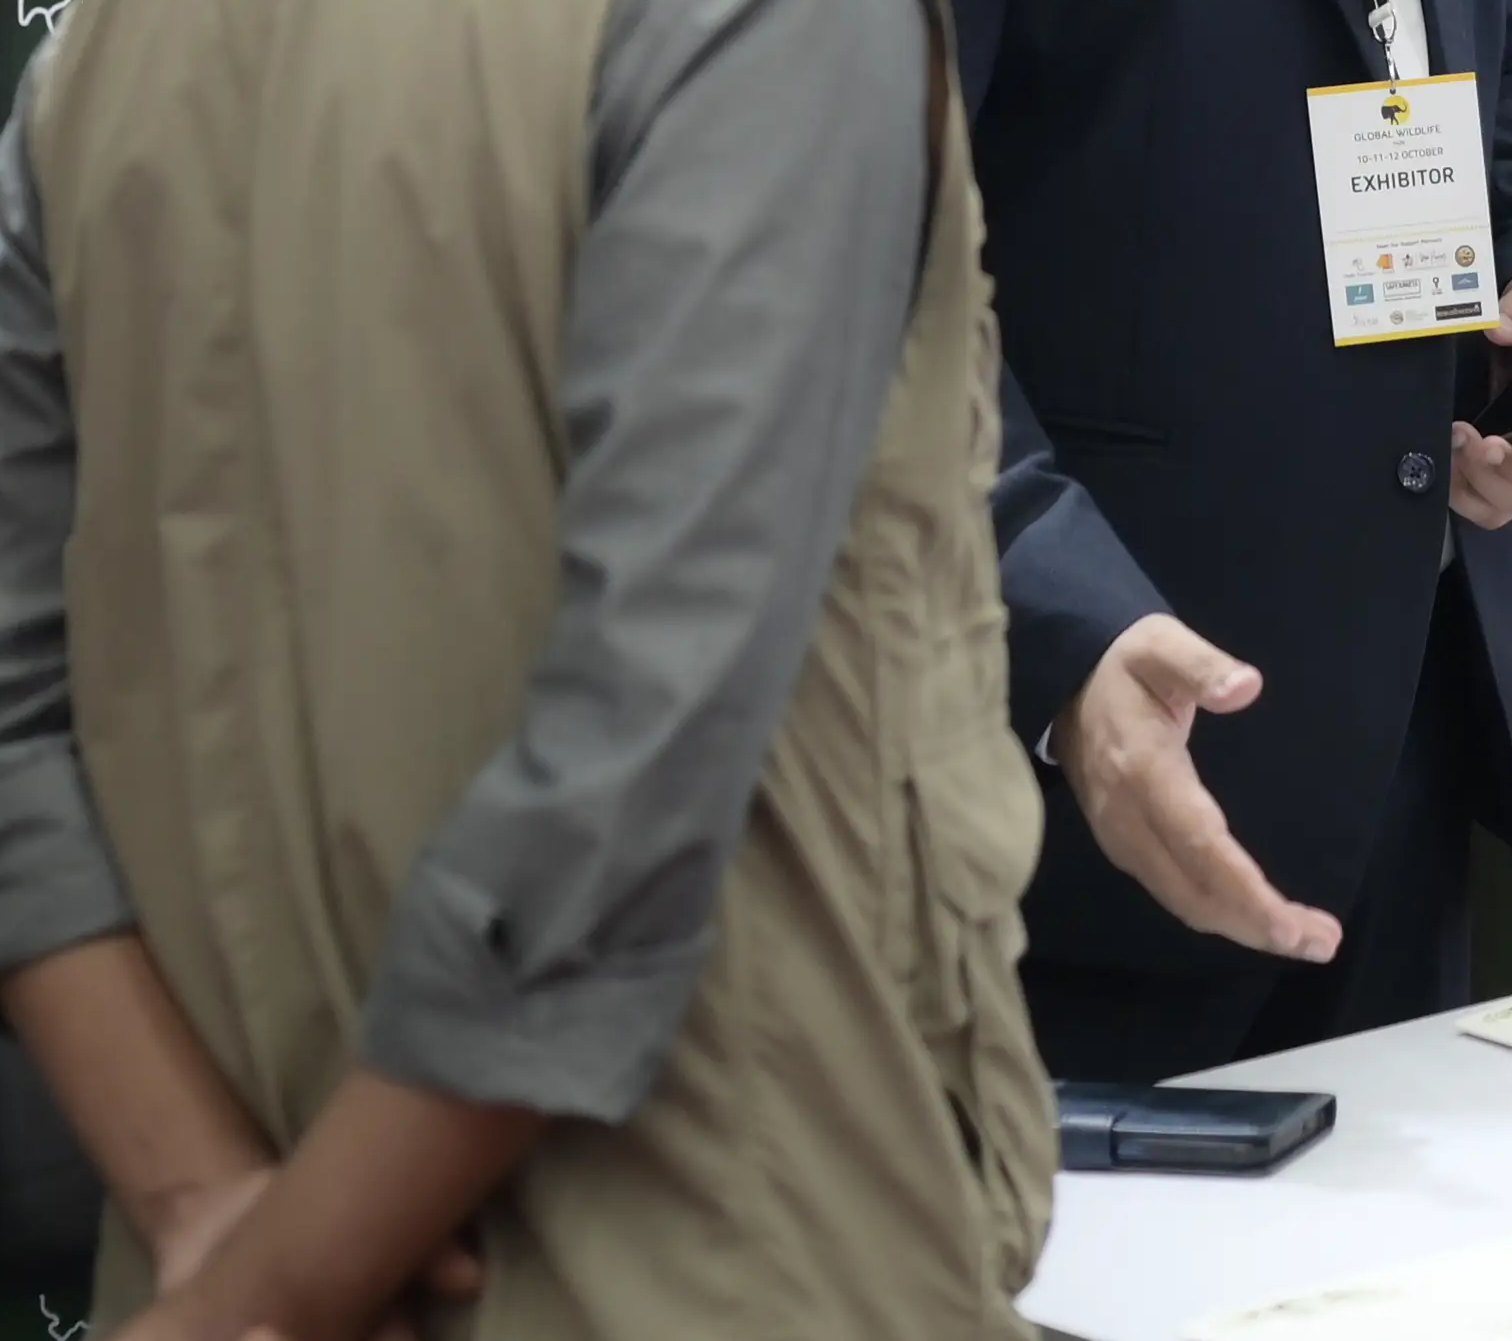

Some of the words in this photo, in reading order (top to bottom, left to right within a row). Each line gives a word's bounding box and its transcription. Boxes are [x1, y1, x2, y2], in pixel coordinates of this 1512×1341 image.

[1354, 128, 1393, 142] GLOBAL
[1396, 124, 1441, 137] WILDLIFE
[1357, 151, 1399, 164] 10-11-12
[1401, 147, 1444, 161] OCTOBER
[1351, 166, 1455, 193] EXHIBITOR
